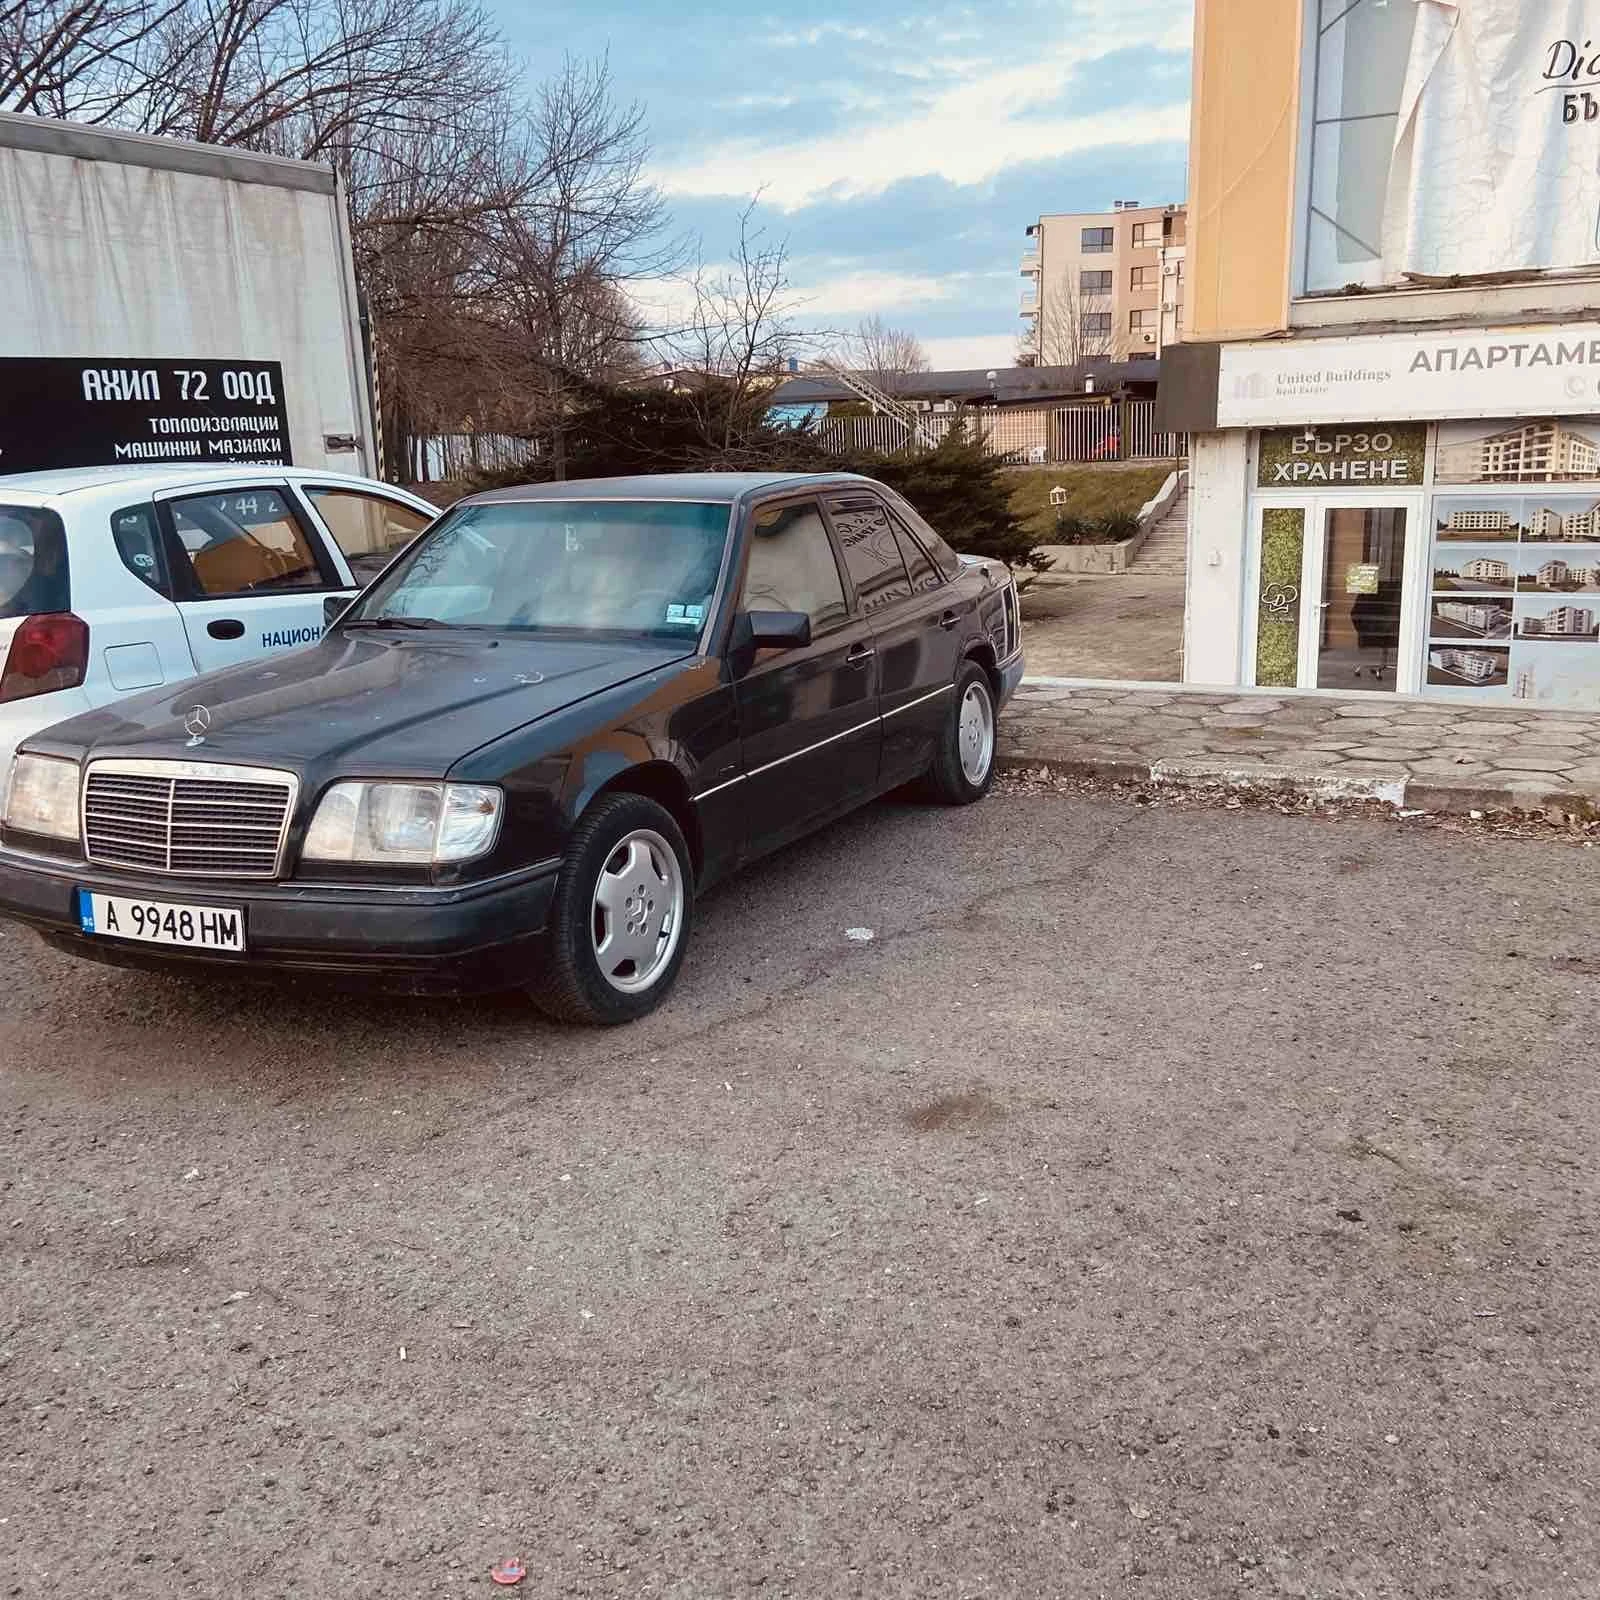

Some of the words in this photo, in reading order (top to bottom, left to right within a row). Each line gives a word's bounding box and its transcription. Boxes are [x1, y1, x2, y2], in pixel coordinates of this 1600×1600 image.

[81, 369, 161, 401] АХИЛ
[173, 370, 210, 401] 72
[222, 370, 276, 405] ООД
[1277, 371, 1321, 385] United
[1326, 369, 1391, 383] Buildings
[149, 415, 279, 434] ТОПЛОИЗОЛАЦИИ
[114, 440, 201, 458] МАШИННИ
[208, 437, 282, 455] МАЗИЛКИ
[1291, 432, 1393, 454] БЪРЗО
[1272, 459, 1409, 481] ХРАНЕНЕ
[131, 904, 195, 941] 9948
